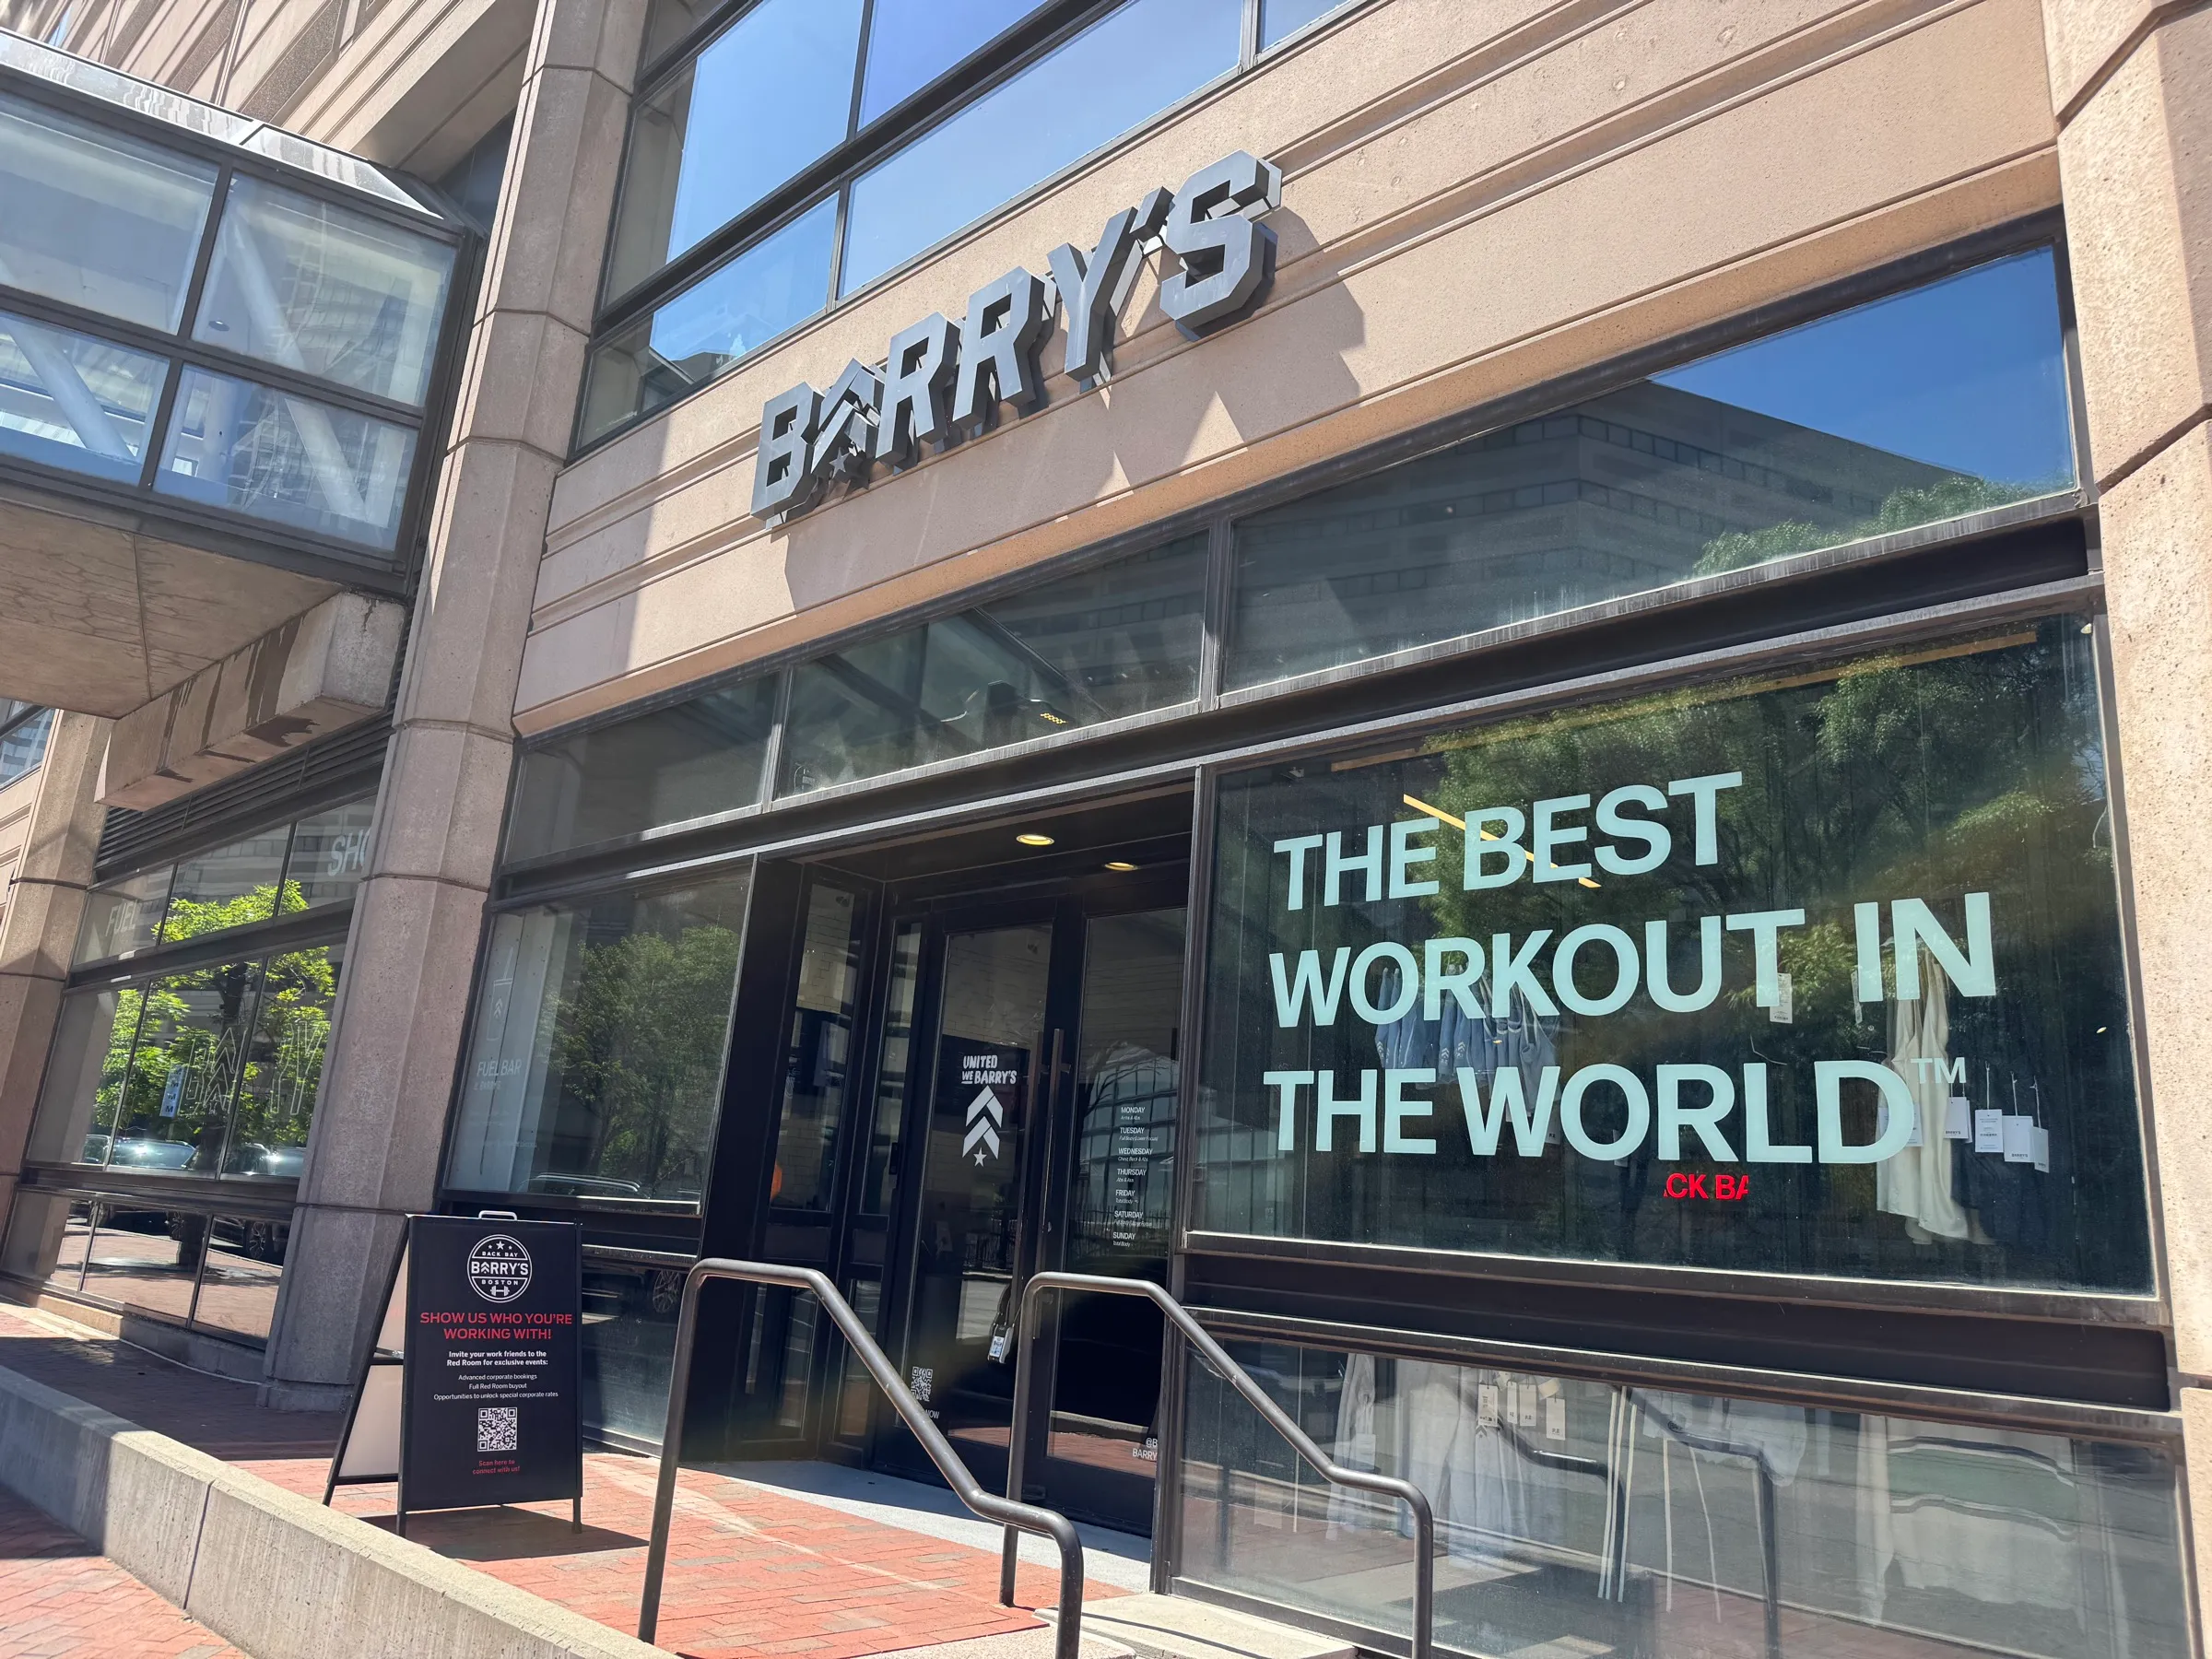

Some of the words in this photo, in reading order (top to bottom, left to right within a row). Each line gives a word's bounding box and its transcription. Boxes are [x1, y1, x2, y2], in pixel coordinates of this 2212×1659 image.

[750, 148, 1282, 524] BARRY'S
[1274, 818, 1439, 911] THE
[1465, 771, 1743, 890] BEST
[105, 898, 140, 937] FUEL
[1270, 908, 1806, 1028] WORKOUT
[1854, 891, 1997, 1002] IN
[477, 1060, 499, 1077] FUEL
[500, 1059, 523, 1076] BAR
[963, 1054, 998, 1069] UNITED
[961, 1071, 973, 1084] WE
[974, 1070, 1018, 1085] BARRY'S
[1264, 1068, 1437, 1154] THE
[1663, 1172, 1710, 1200] CK
[1112, 1231, 1135, 1240] SUNDAY
[471, 1262, 528, 1276] BARRY'S
[420, 1312, 465, 1324] SHOW
[467, 1312, 487, 1324] US
[490, 1312, 523, 1324] WHO
[524, 1313, 572, 1324] YOU'RE
[443, 1328, 511, 1339] WORKING
[513, 1328, 551, 1339] WITH!
